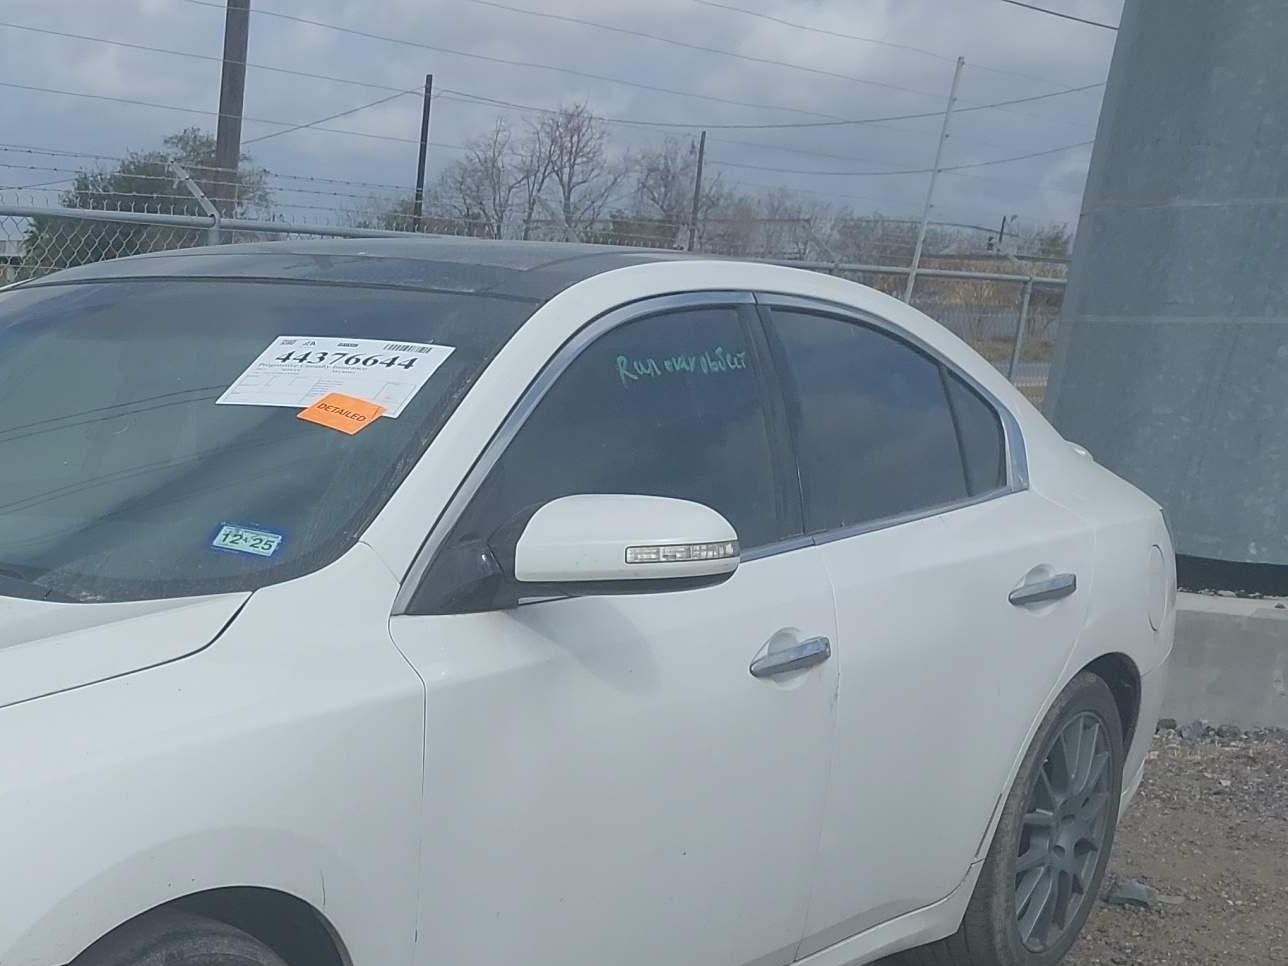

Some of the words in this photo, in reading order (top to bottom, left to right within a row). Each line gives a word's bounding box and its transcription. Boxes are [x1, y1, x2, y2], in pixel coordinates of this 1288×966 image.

[274, 349, 419, 371] 44376644
[616, 355, 661, 387] Run
[316, 402, 367, 423] DETAILED
[221, 530, 244, 546] 12
[248, 537, 276, 551] 25
